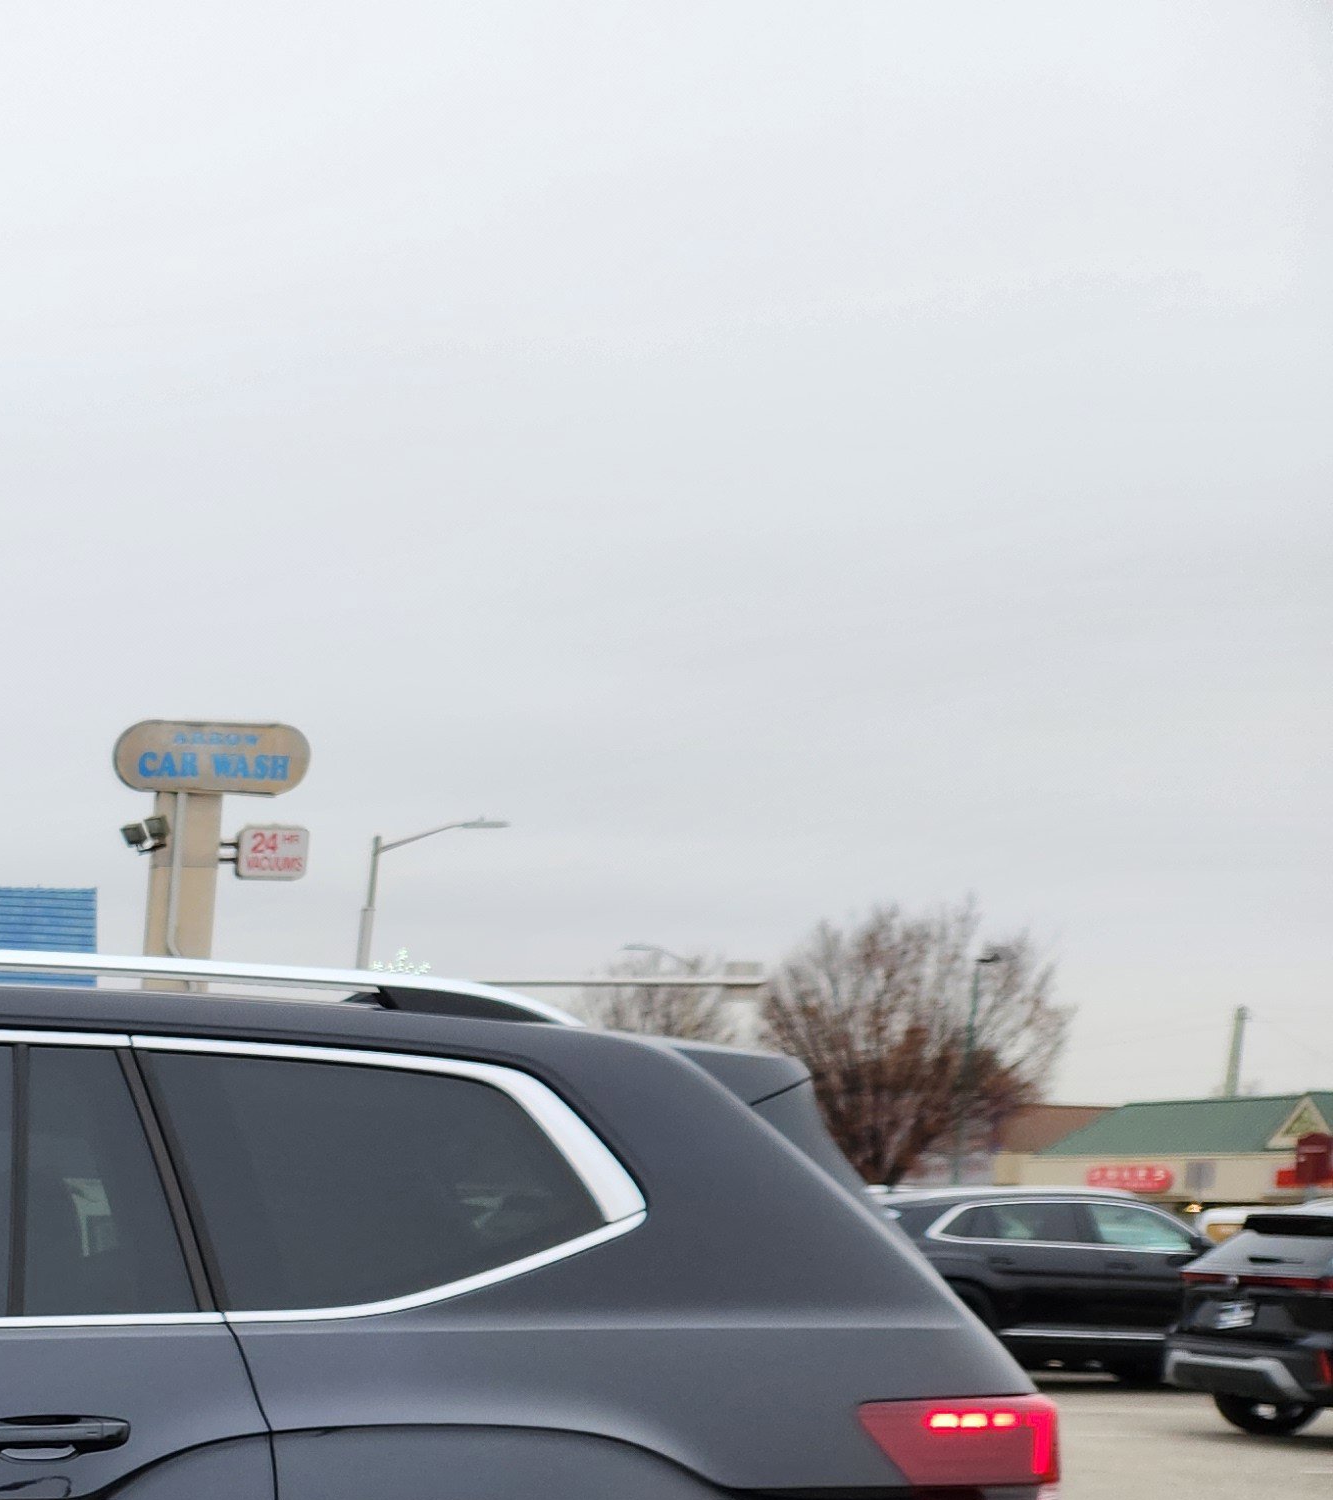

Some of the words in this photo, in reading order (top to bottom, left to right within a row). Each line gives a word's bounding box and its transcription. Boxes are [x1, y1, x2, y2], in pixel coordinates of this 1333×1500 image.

[138, 751, 200, 780] CAR
[211, 753, 291, 782] WASH
[251, 831, 278, 853] 24
